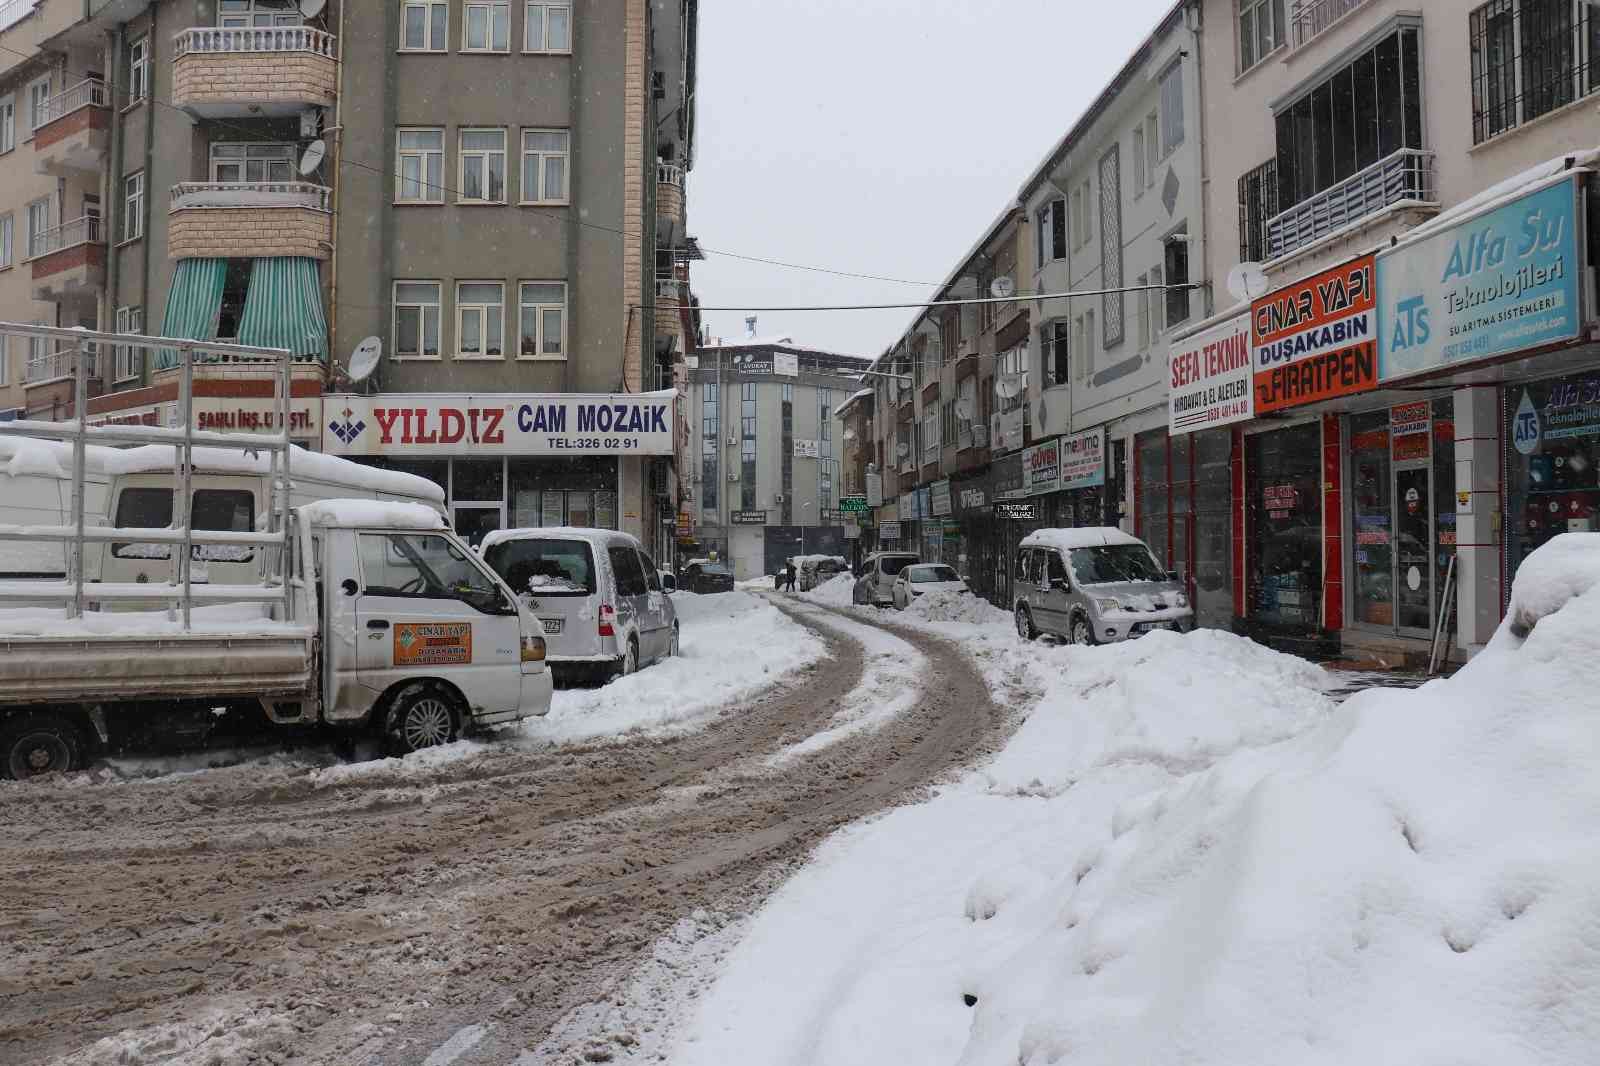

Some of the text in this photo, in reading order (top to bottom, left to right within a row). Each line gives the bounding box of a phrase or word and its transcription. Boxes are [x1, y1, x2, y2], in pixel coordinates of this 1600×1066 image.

[1441, 207, 1564, 285] Alfa Su
[1256, 265, 1371, 345] ÇINAR YAPI
[1443, 255, 1563, 315] Teknolojileri
[1391, 294, 1431, 353] ATS
[1171, 328, 1250, 389] SEFA TEKNİK
[1272, 342, 1373, 402] FIRATPEN
[373, 408, 505, 444] YILDIZ
[517, 404, 567, 433] CAM
[1174, 391, 1202, 413] HIRDAVAT
[1203, 391, 1208, 407] &
[1208, 387, 1217, 405] EL
[1516, 412, 1537, 442] ATS
[547, 438, 639, 449] TEL:326 02 91
